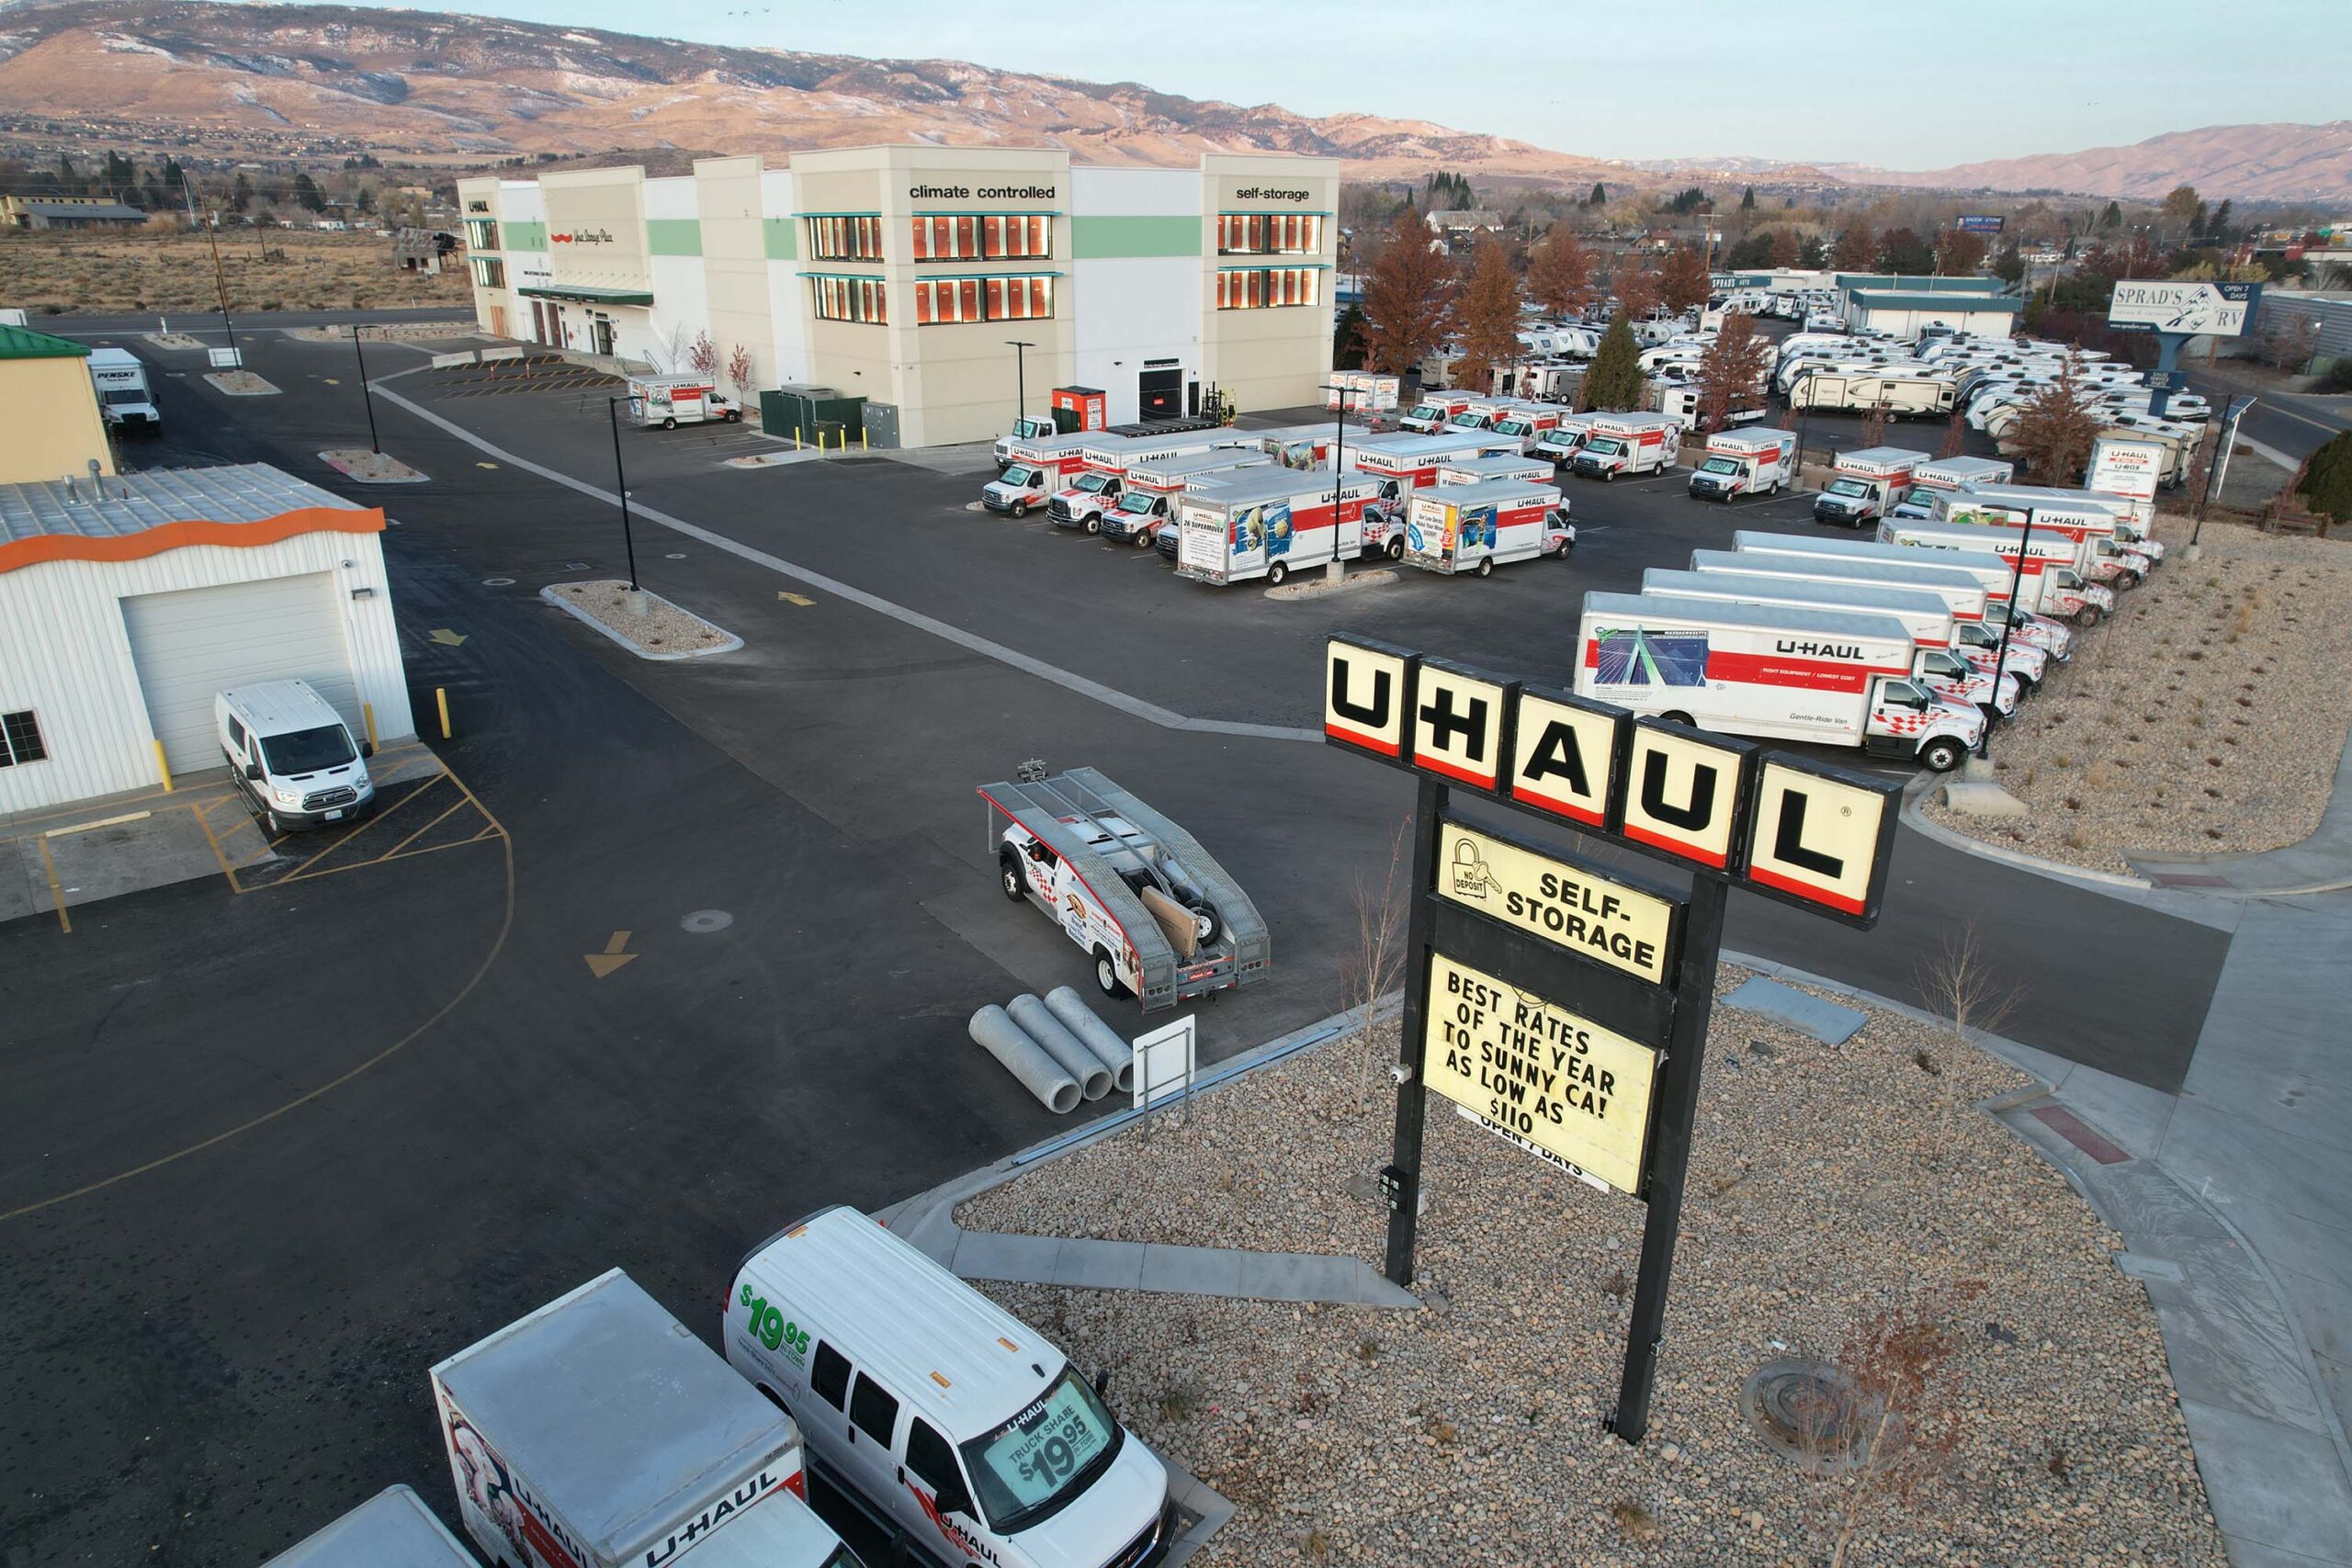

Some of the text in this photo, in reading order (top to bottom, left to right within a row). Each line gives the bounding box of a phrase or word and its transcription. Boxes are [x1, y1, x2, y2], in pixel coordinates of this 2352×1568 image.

[910, 186, 1055, 198] climate controlled
[1237, 187, 1309, 202] self-storage
[2115, 288, 2183, 305] SPRAD'S
[2217, 310, 2243, 327] RV
[1597, 422, 1625, 433] U-HAUL
[1013, 448, 1036, 459] U-HAUL
[1712, 440, 1745, 452] U-HAUL
[1085, 451, 1114, 466] U-HAUL
[1360, 454, 1396, 468] U-HAUL
[1418, 455, 1453, 467] U-HAUL
[2111, 450, 2149, 459] U-HAUL
[1840, 461, 1876, 473] U-HAUL
[1131, 472, 1159, 485] U-HAUL
[1918, 470, 1956, 483] U-HAUL
[1517, 497, 1546, 508] U-HAUL
[2041, 515, 2087, 526] U-HAUL
[1776, 639, 1865, 660] U-HAUL
[1779, 669, 1812, 677] EQUIPMENT
[1789, 712, 1849, 725] Gentle-Ride Van
[1464, 871, 1474, 881] NO
[1455, 878, 1484, 893] DEPOSIT
[1540, 873, 1631, 922] SELF-
[1506, 891, 1655, 970] STORAGE
[1447, 970, 1590, 1055] BEST RATES
[1456, 1002, 1616, 1097] OF THE YEAR
[1443, 1021, 1608, 1119] TO SUNNY CA!
[1446, 1049, 1564, 1125] AS LOW AS
[1490, 1097, 1533, 1134] $110
[1480, 1115, 1522, 1145] OPEN
[1541, 1147, 1584, 1177] DAYS
[780, 1344, 806, 1368] IN-TOWN
[1006, 1399, 1049, 1433] U-HAUL
[1009, 1404, 1075, 1464] TRUCK SHARE
[1072, 1434, 1095, 1453] IN-TOWN
[645, 1472, 779, 1568] U-HAUL
[939, 1513, 1002, 1568] U-HAUL
